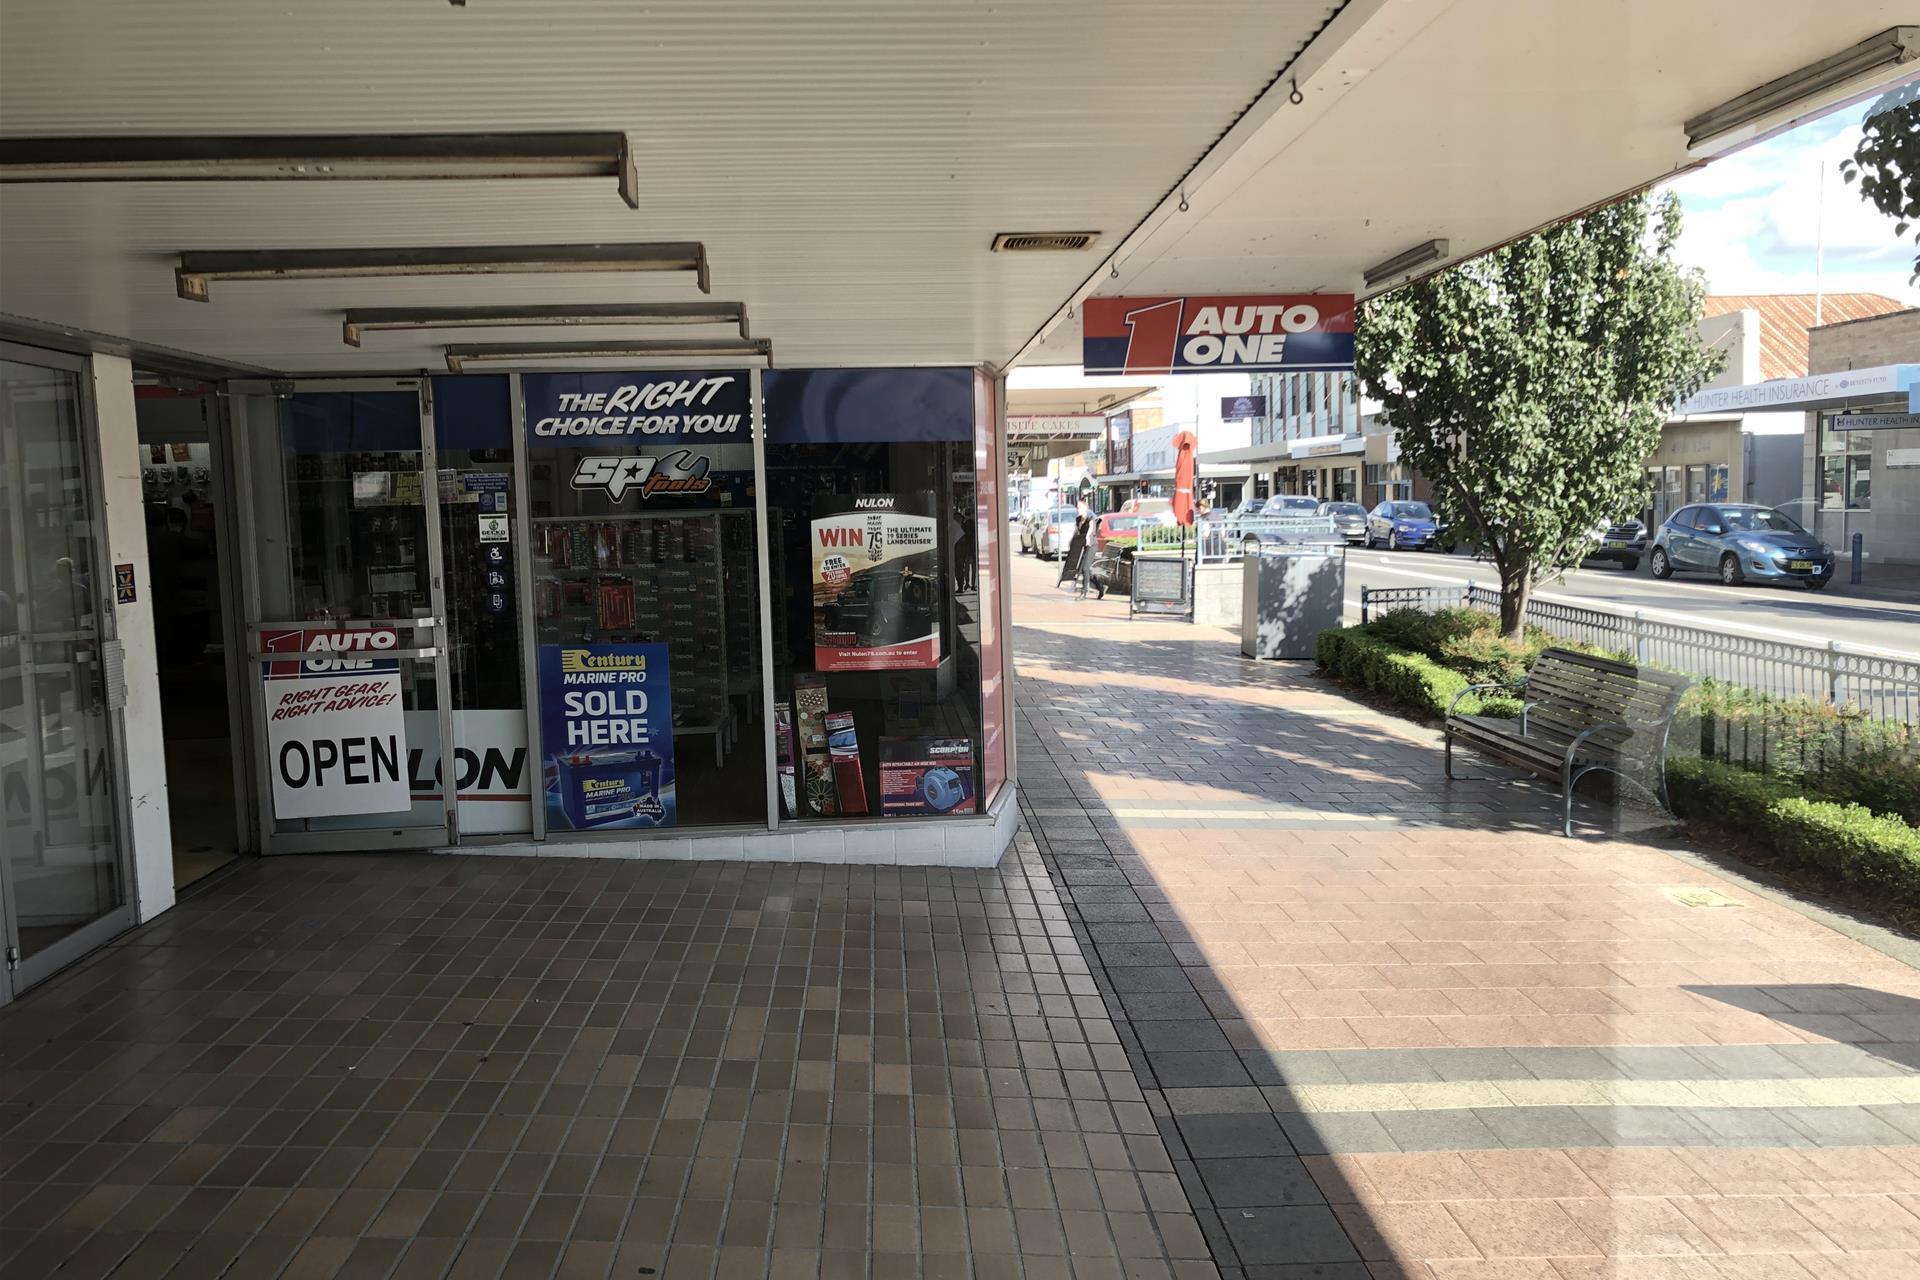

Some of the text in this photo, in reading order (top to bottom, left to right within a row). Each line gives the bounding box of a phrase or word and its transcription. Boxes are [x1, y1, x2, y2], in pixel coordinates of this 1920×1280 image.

[1186, 304, 1319, 335] AUTO
[1183, 334, 1287, 365] ONE
[558, 376, 735, 416] THE RIGHT
[1695, 393, 1729, 409] HUNTER
[1731, 388, 1765, 405] HEALTH
[1768, 378, 1830, 401] INSURANCE
[535, 414, 741, 436] CHOICE FOR YOU!
[1041, 420, 1081, 430] CAKES
[1846, 418, 1878, 426] HUNTER
[1880, 416, 1908, 425] HEALTH
[643, 472, 710, 495] tools
[855, 498, 894, 508] NULON
[818, 528, 863, 547] WIN
[824, 557, 842, 566] FREE
[307, 631, 396, 652] AUTO
[305, 658, 374, 672] ONE
[562, 649, 646, 672] Century
[563, 671, 647, 685] MARINE PRO
[280, 681, 389, 706] RIGHT GEAR!
[564, 690, 648, 717] SOLD
[271, 693, 397, 720] RIGHT ADVICE!
[567, 718, 650, 745] HERE
[929, 745, 969, 755] SCORPION
[280, 735, 399, 789] OPEN
[582, 779, 625, 792] Century
[585, 786, 631, 799] MARINE PRO
